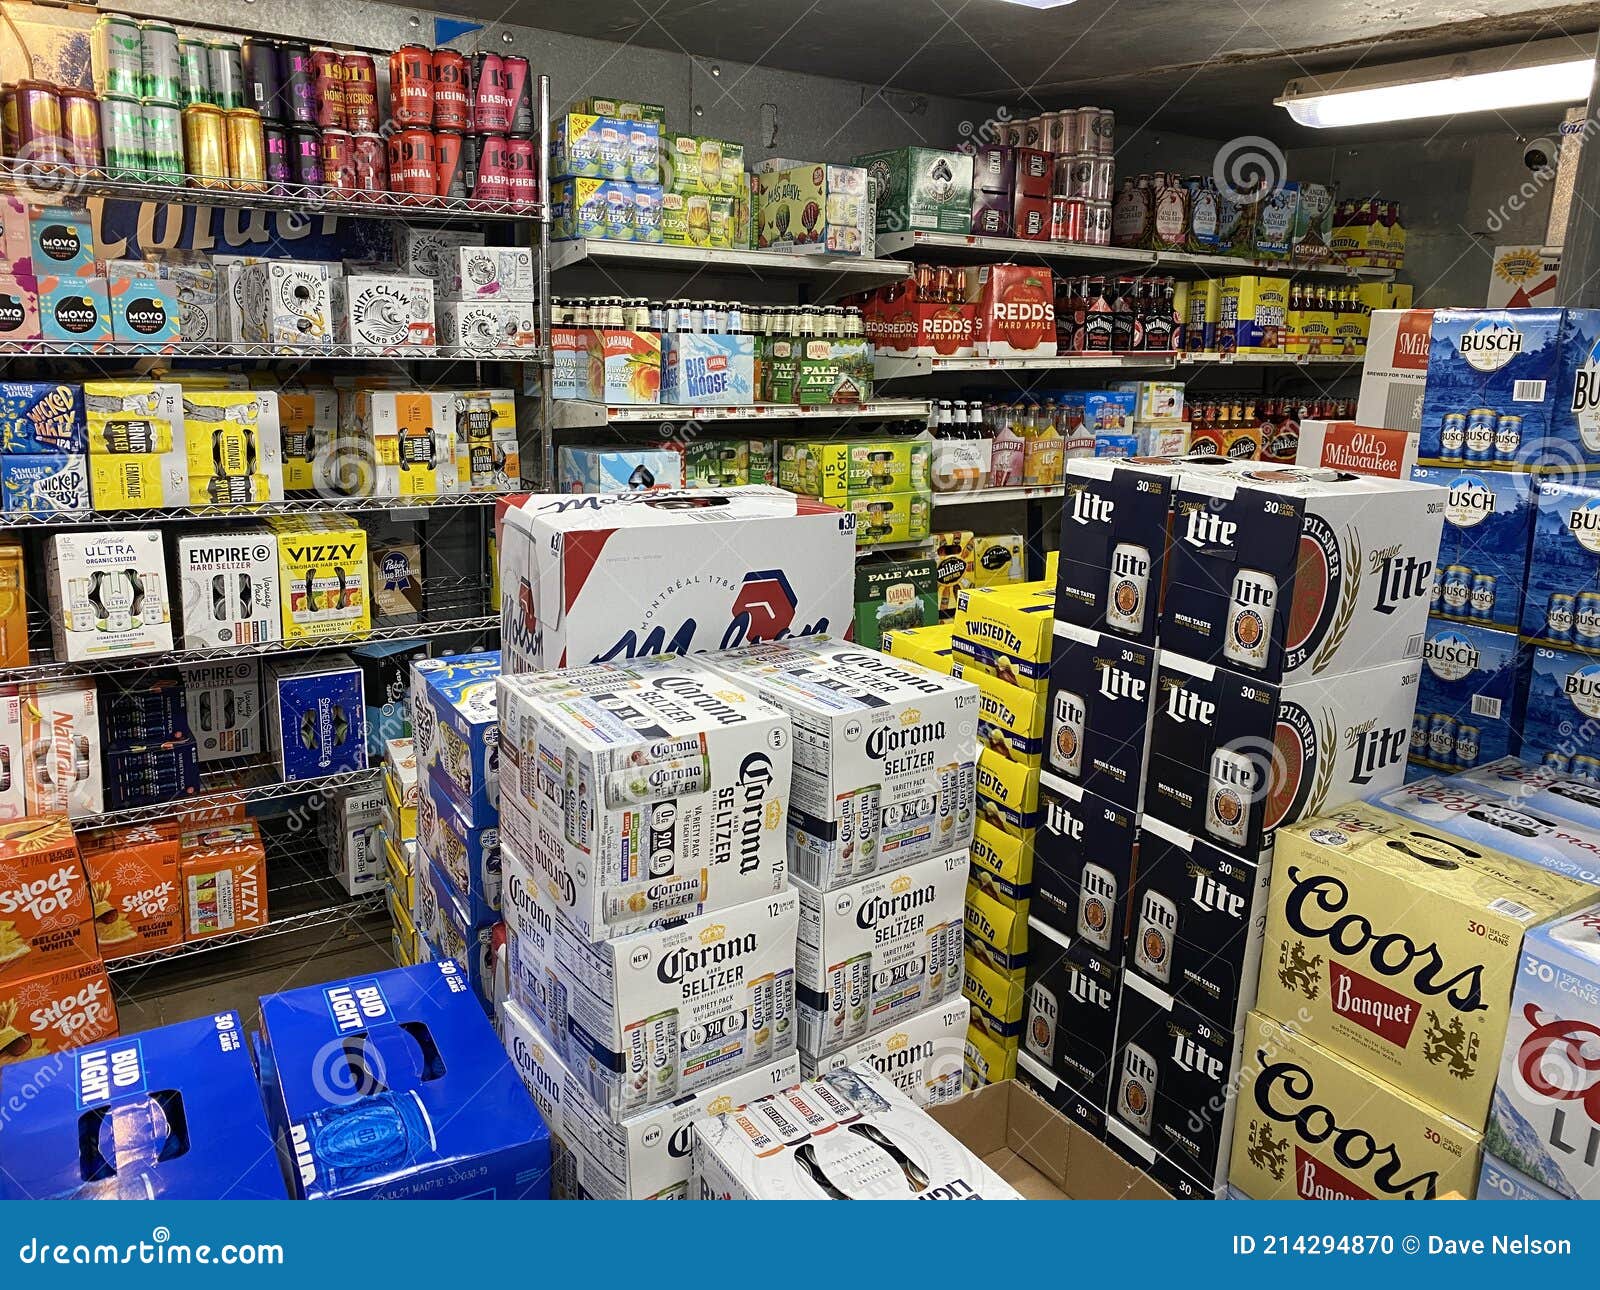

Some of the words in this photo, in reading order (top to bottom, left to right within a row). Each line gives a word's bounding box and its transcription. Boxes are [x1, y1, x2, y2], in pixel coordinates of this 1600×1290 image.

[573, 119, 592, 137] PACK
[579, 182, 598, 200] PACK
[42, 238, 77, 248] MOVO
[295, 271, 322, 290] WHITE
[57, 310, 94, 320] MOVO
[129, 312, 163, 321] MOVO
[354, 289, 374, 325] WHITE
[376, 286, 410, 305] CLAW
[475, 309, 498, 323] CLAW
[993, 302, 1055, 321] REDD'S
[923, 318, 971, 333] REDD'S
[998, 321, 1021, 329] HARD
[1025, 320, 1051, 330] APPLE
[1460, 334, 1522, 352] BUSCH
[685, 356, 706, 377] BIG
[803, 366, 839, 375] PALE
[687, 373, 728, 397] MOOSE
[806, 376, 835, 385] ALE
[112, 423, 124, 452] SPIKED
[992, 442, 1023, 451] SMIRNOFF
[1033, 441, 1063, 450] SMIRNOFF
[1067, 440, 1095, 449] SMIRNOFF
[1352, 433, 1386, 456] Old
[227, 435, 239, 470] LEMONADE
[1326, 442, 1397, 472] Milwaukee
[125, 462, 141, 499] LEMONADE
[826, 465, 836, 478] 15
[837, 451, 847, 489] PACK
[1413, 469, 1427, 477] 30
[1136, 480, 1149, 492] 30
[1071, 489, 1115, 525] Lite
[1264, 501, 1279, 513] 30
[844, 512, 856, 529] 30
[1184, 509, 1237, 548] Lite
[85, 544, 135, 557] ULTRA
[189, 547, 250, 564] EMPIRE
[287, 544, 356, 562] VIZZY
[1303, 517, 1338, 580] PILSNER
[86, 557, 112, 565] ORGANIC
[190, 563, 212, 572] HARD
[214, 562, 251, 570] SELTZER
[937, 561, 965, 578] mike's
[1113, 553, 1147, 578] Lite
[709, 576, 736, 591] 1786
[868, 572, 902, 582] PALE
[905, 567, 931, 577] ALE
[1234, 579, 1273, 607] Lite
[1373, 557, 1432, 615] Lite
[966, 620, 1004, 642] TWISTED
[1004, 630, 1022, 653] TEA
[1423, 643, 1479, 667] BUSCH
[1099, 663, 1146, 702] Lite
[1240, 686, 1255, 699] 30
[636, 691, 696, 724] SELTZER
[954, 695, 964, 709] 12
[1165, 684, 1215, 726] Lite
[997, 702, 1016, 728] TEA
[773, 730, 781, 746] NEW
[846, 726, 860, 735] NEW
[865, 720, 946, 761] Corona
[1278, 705, 1315, 760] PILSNER
[884, 750, 934, 776] SELTZER
[1349, 727, 1406, 785] Lite
[648, 764, 700, 788] Corona
[913, 779, 926, 789] PACK
[735, 751, 774, 876] Corona
[1045, 800, 1084, 842] Lite
[715, 787, 734, 865] SELTZER
[121, 881, 176, 911] SHOCK
[241, 865, 259, 923] VIZZY
[647, 878, 699, 900] Corona
[1191, 871, 1244, 919] Lite
[21, 887, 73, 921] TOP
[137, 897, 169, 919] TOP
[652, 892, 694, 912] SELTZER
[768, 902, 778, 918] 12
[838, 900, 850, 908] NEW
[856, 884, 936, 930] Corona
[1143, 897, 1175, 930] Lite
[31, 928, 81, 947] BELGIAN
[137, 921, 173, 934] BELGIAN
[143, 929, 168, 939] WHITE
[875, 913, 924, 944] SELTZER
[976, 917, 996, 942] TEA
[1467, 919, 1486, 937] 30
[1487, 934, 1509, 947] CANS
[40, 939, 75, 952] WHITE
[1284, 865, 1489, 1013] Coors
[437, 960, 457, 976] 30
[632, 952, 649, 963] NEW
[656, 932, 758, 984] Corona
[682, 965, 744, 999] SELTZER
[1068, 968, 1112, 1011] Lite
[1524, 959, 1554, 983] 30
[1559, 981, 1599, 1004] CANS
[30, 980, 107, 1031] SHOCK
[328, 987, 363, 1031] LIGHT
[354, 984, 389, 1019] BUD
[692, 1000, 714, 1015] VARIETY
[714, 994, 734, 1008] PACK
[1336, 974, 1412, 1027] Banquet
[214, 1013, 233, 1031] 30
[708, 1023, 722, 1037] 90
[943, 1013, 953, 1027] 12
[111, 1046, 138, 1088] BUD
[1171, 1034, 1224, 1083] Lite
[79, 1049, 109, 1104] LIGHT
[645, 1129, 660, 1141] NEW
[1254, 1049, 1440, 1200] Coors
[1424, 1127, 1441, 1145] 30
